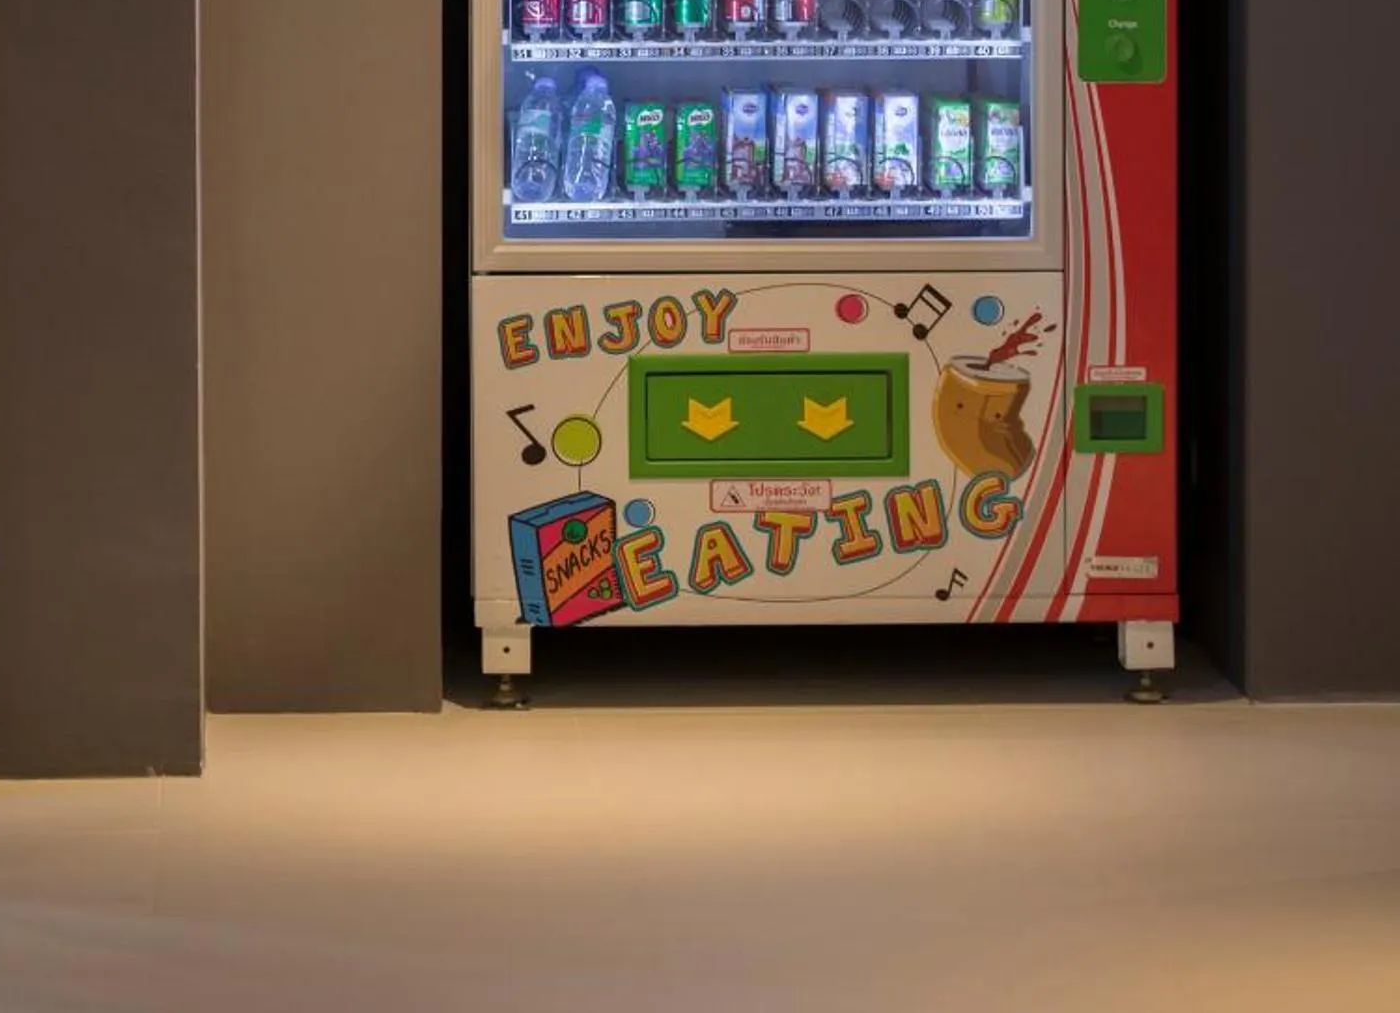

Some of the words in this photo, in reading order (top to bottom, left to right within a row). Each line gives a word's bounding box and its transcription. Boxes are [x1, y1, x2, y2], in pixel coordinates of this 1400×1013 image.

[497, 287, 738, 370] ENJOY
[543, 529, 613, 595] SNACKS
[613, 470, 1024, 612] EATING
